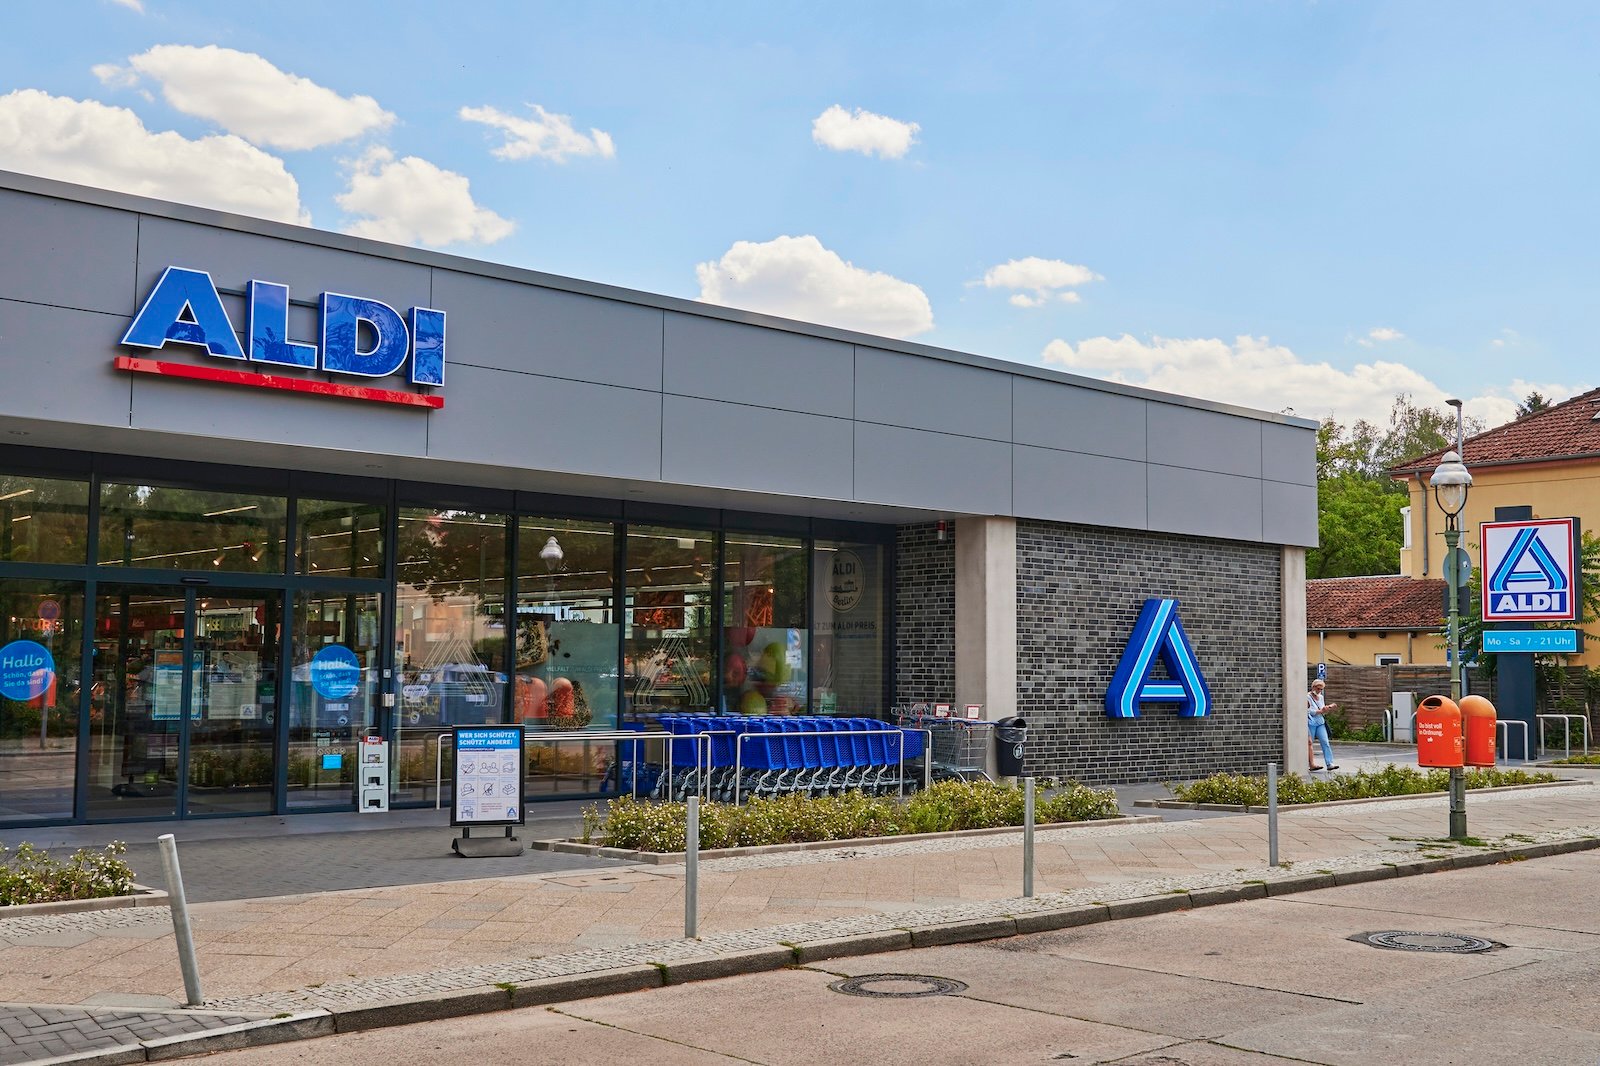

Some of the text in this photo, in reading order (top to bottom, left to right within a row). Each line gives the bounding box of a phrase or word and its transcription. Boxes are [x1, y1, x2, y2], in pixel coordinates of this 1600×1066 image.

[121, 265, 447, 387] ALDI
[832, 562, 856, 575] ALDI
[832, 595, 854, 606] Berlin
[1496, 593, 1560, 612] ALDI
[1509, 637, 1520, 645] Sa
[1526, 637, 1532, 645] 7
[1540, 637, 1551, 645] 21
[1554, 637, 1571, 645] Uhr
[3, 654, 46, 669] Hallo
[1319, 664, 1325, 674] P
[459, 738, 486, 746] SCHÜTZT
